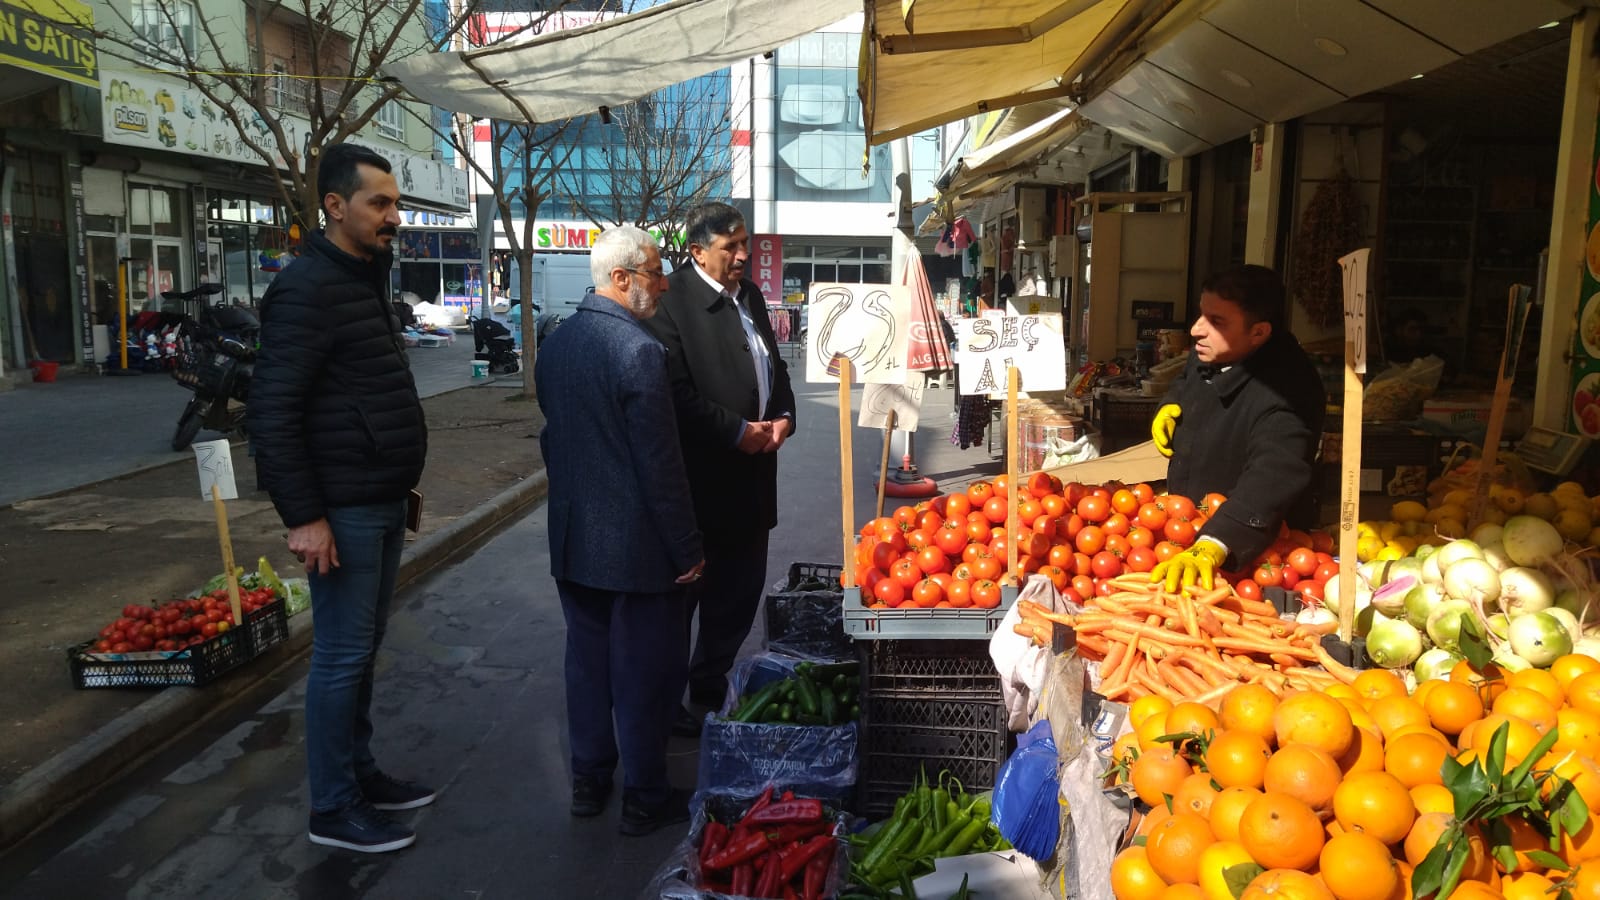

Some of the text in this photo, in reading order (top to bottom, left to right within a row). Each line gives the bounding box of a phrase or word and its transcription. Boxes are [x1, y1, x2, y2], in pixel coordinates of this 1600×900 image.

[23, 18, 96, 77] SATIŞ
[115, 106, 147, 129] pilsan
[969, 316, 1040, 351] SEÇ
